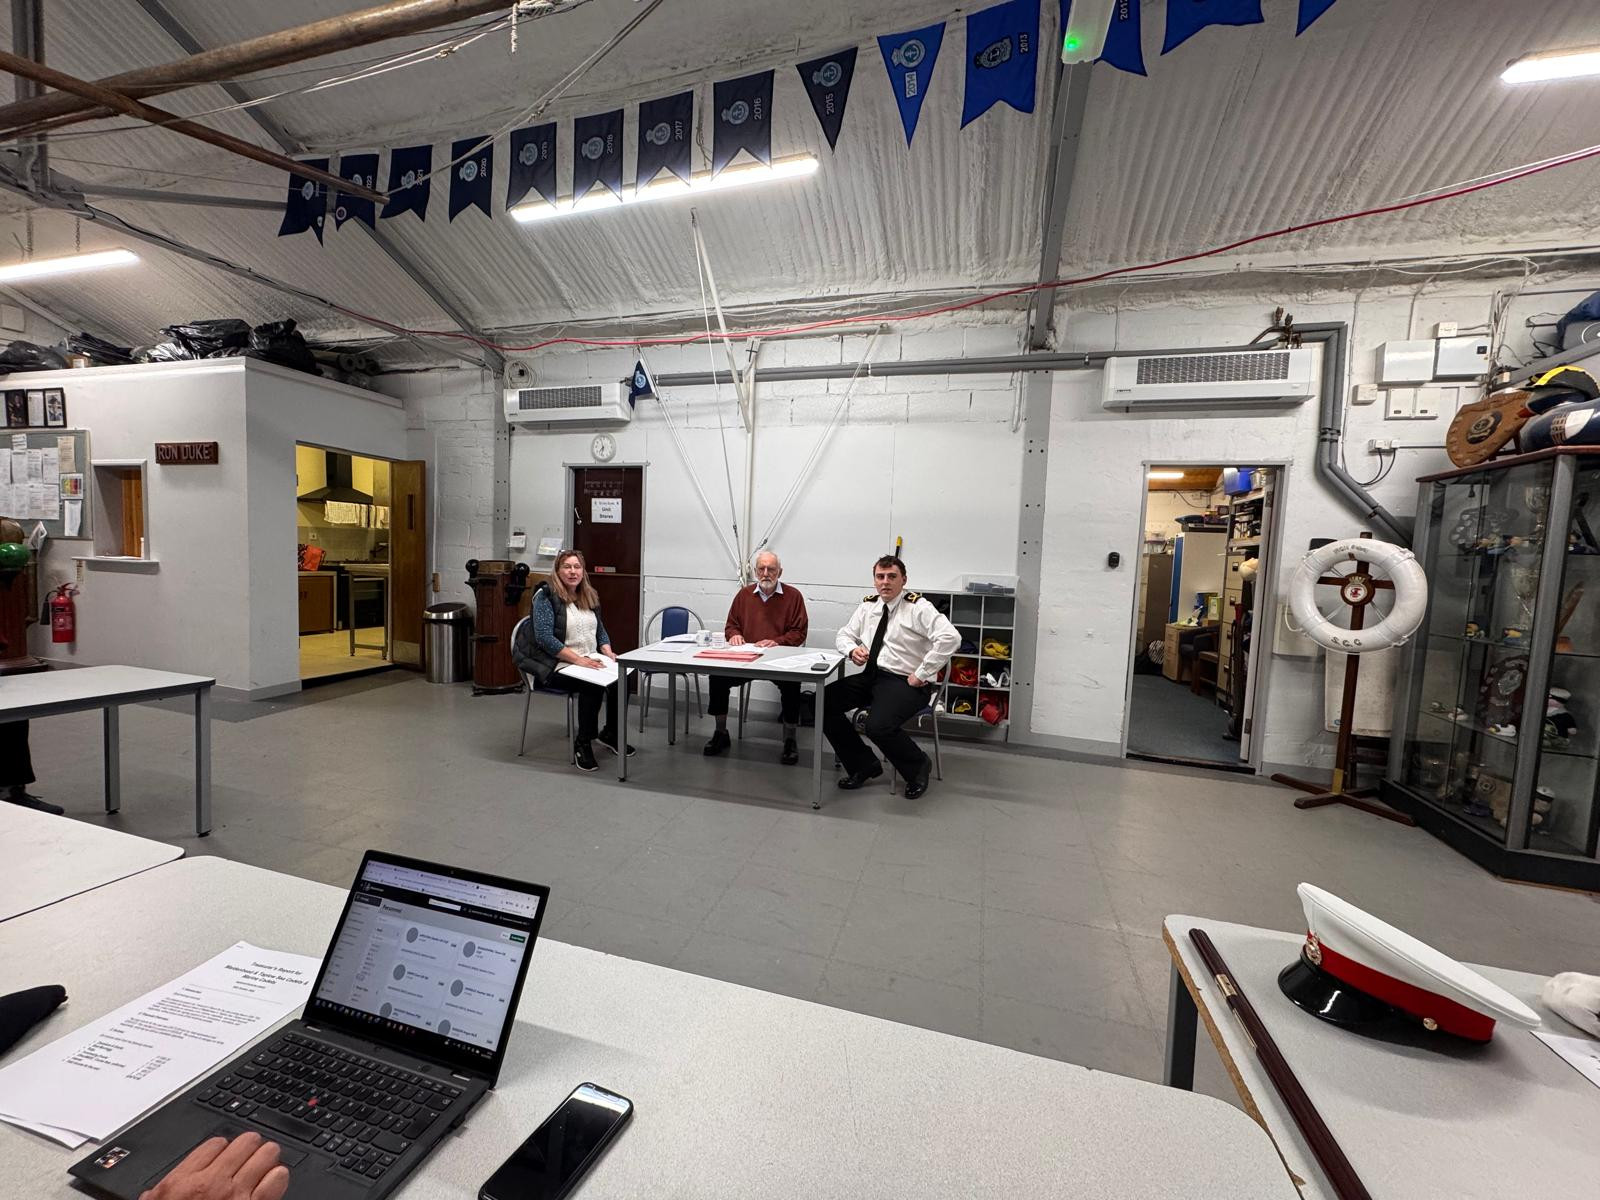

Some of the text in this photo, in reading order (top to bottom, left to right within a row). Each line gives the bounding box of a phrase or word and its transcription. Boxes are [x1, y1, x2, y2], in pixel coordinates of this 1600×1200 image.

[1020, 34, 1029, 53] 2013
[907, 74, 916, 96] 2014
[753, 97, 762, 120] 2016
[825, 93, 834, 115] 2015
[182, 444, 210, 460] DUKE
